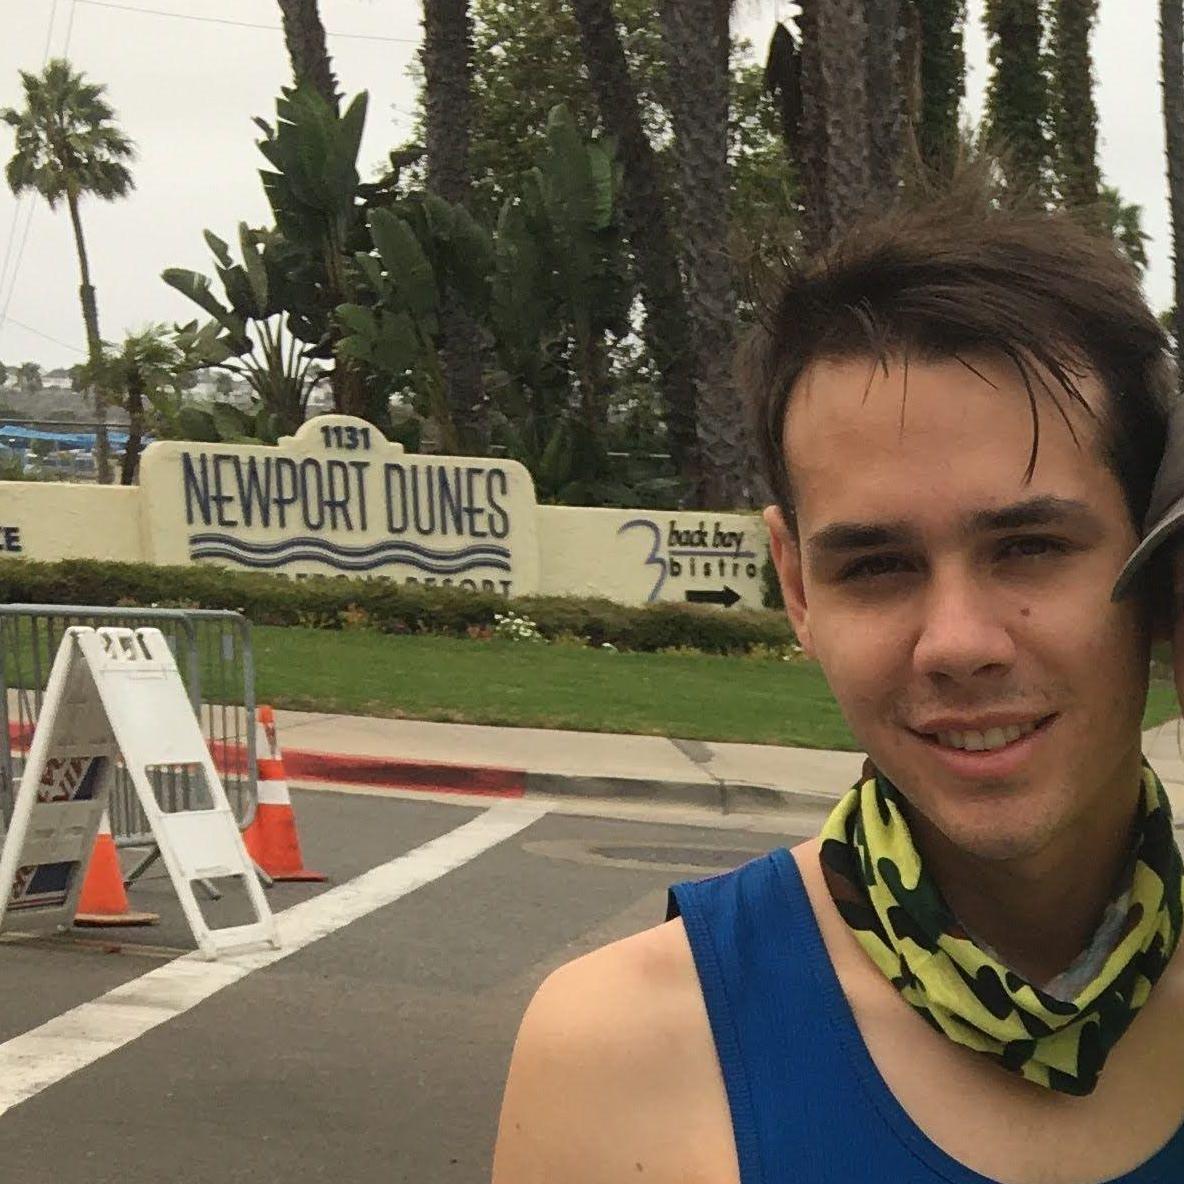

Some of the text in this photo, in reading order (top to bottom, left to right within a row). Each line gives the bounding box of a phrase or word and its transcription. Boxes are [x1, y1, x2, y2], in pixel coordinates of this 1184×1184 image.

[320, 425, 371, 450] 1131
[181, 452, 511, 538] NEWPORT DUNES
[667, 520, 745, 560] back bay
[669, 556, 757, 578] bistro
